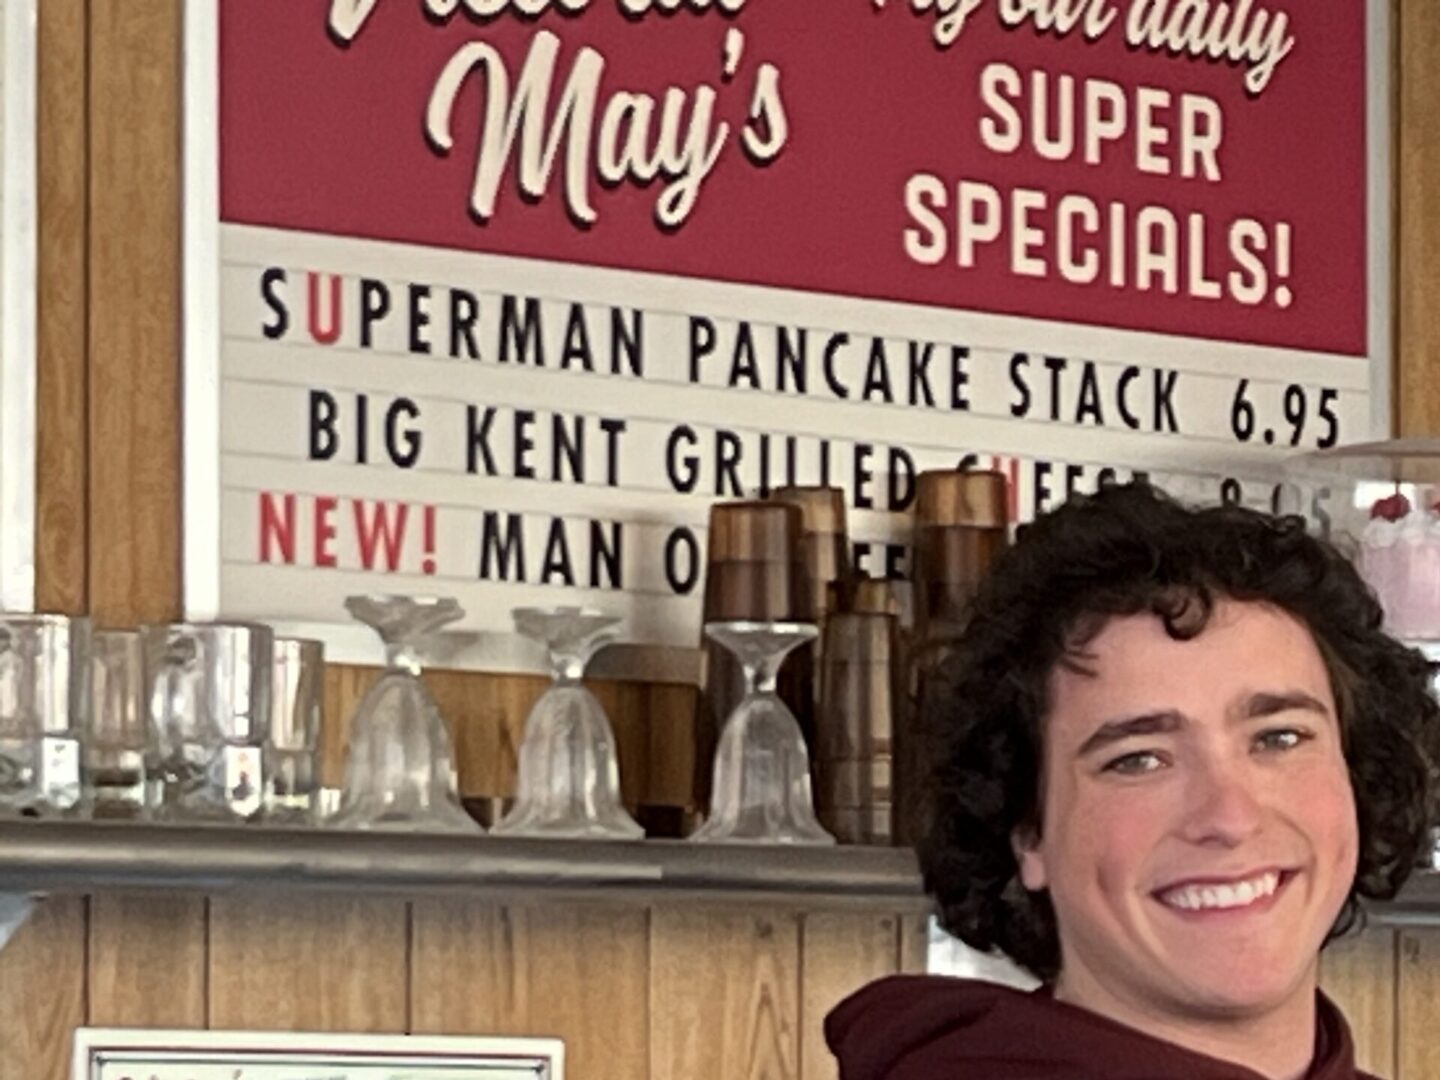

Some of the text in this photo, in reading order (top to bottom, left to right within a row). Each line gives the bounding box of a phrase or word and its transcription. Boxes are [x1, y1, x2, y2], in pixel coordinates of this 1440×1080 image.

[423, 27, 788, 232] May's
[979, 63, 1223, 181] SUPER
[903, 173, 1294, 308] SPECIALS!
[259, 266, 1339, 449] SUPERMAN PANCAKE STACK 6.95
[309, 390, 423, 468] BIG
[466, 404, 626, 487] KENT
[258, 491, 437, 575] NEW!
[479, 511, 623, 589] MAN
